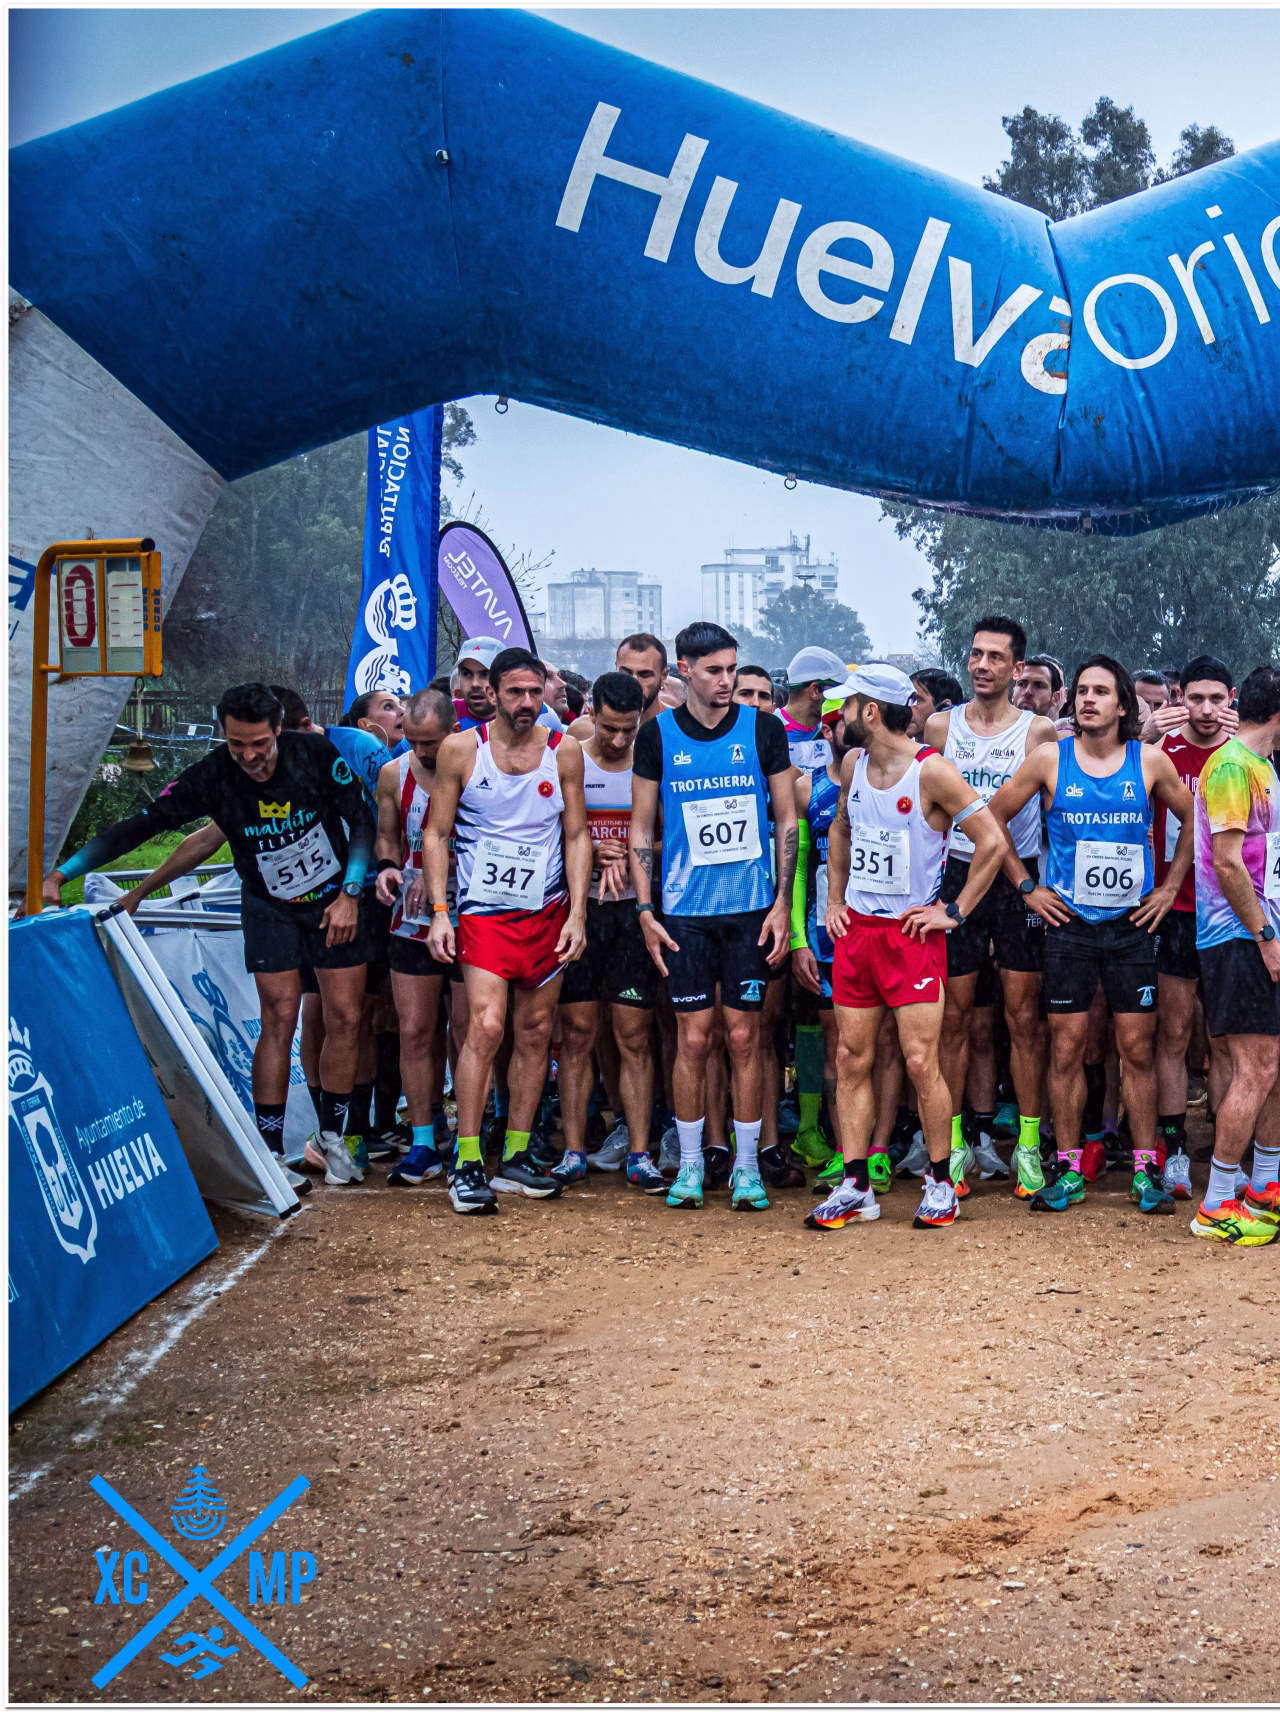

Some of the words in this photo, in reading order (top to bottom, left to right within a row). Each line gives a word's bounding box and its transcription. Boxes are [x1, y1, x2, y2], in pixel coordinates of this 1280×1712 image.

[670, 775, 755, 793] TROTASIERRA
[244, 809, 316, 837] maldito
[1061, 812, 1143, 825] TROTASIERRA
[589, 826, 630, 839] ARCH
[699, 820, 747, 847] 607
[816, 836, 829, 849] CLU
[277, 848, 324, 886] 515
[852, 848, 893, 877] 351
[482, 862, 536, 891] 347
[1085, 865, 1134, 890] 606
[75, 1104, 135, 1154] Ayuntamiento
[133, 1095, 147, 1123] de
[87, 1132, 168, 1210] HUELVA
